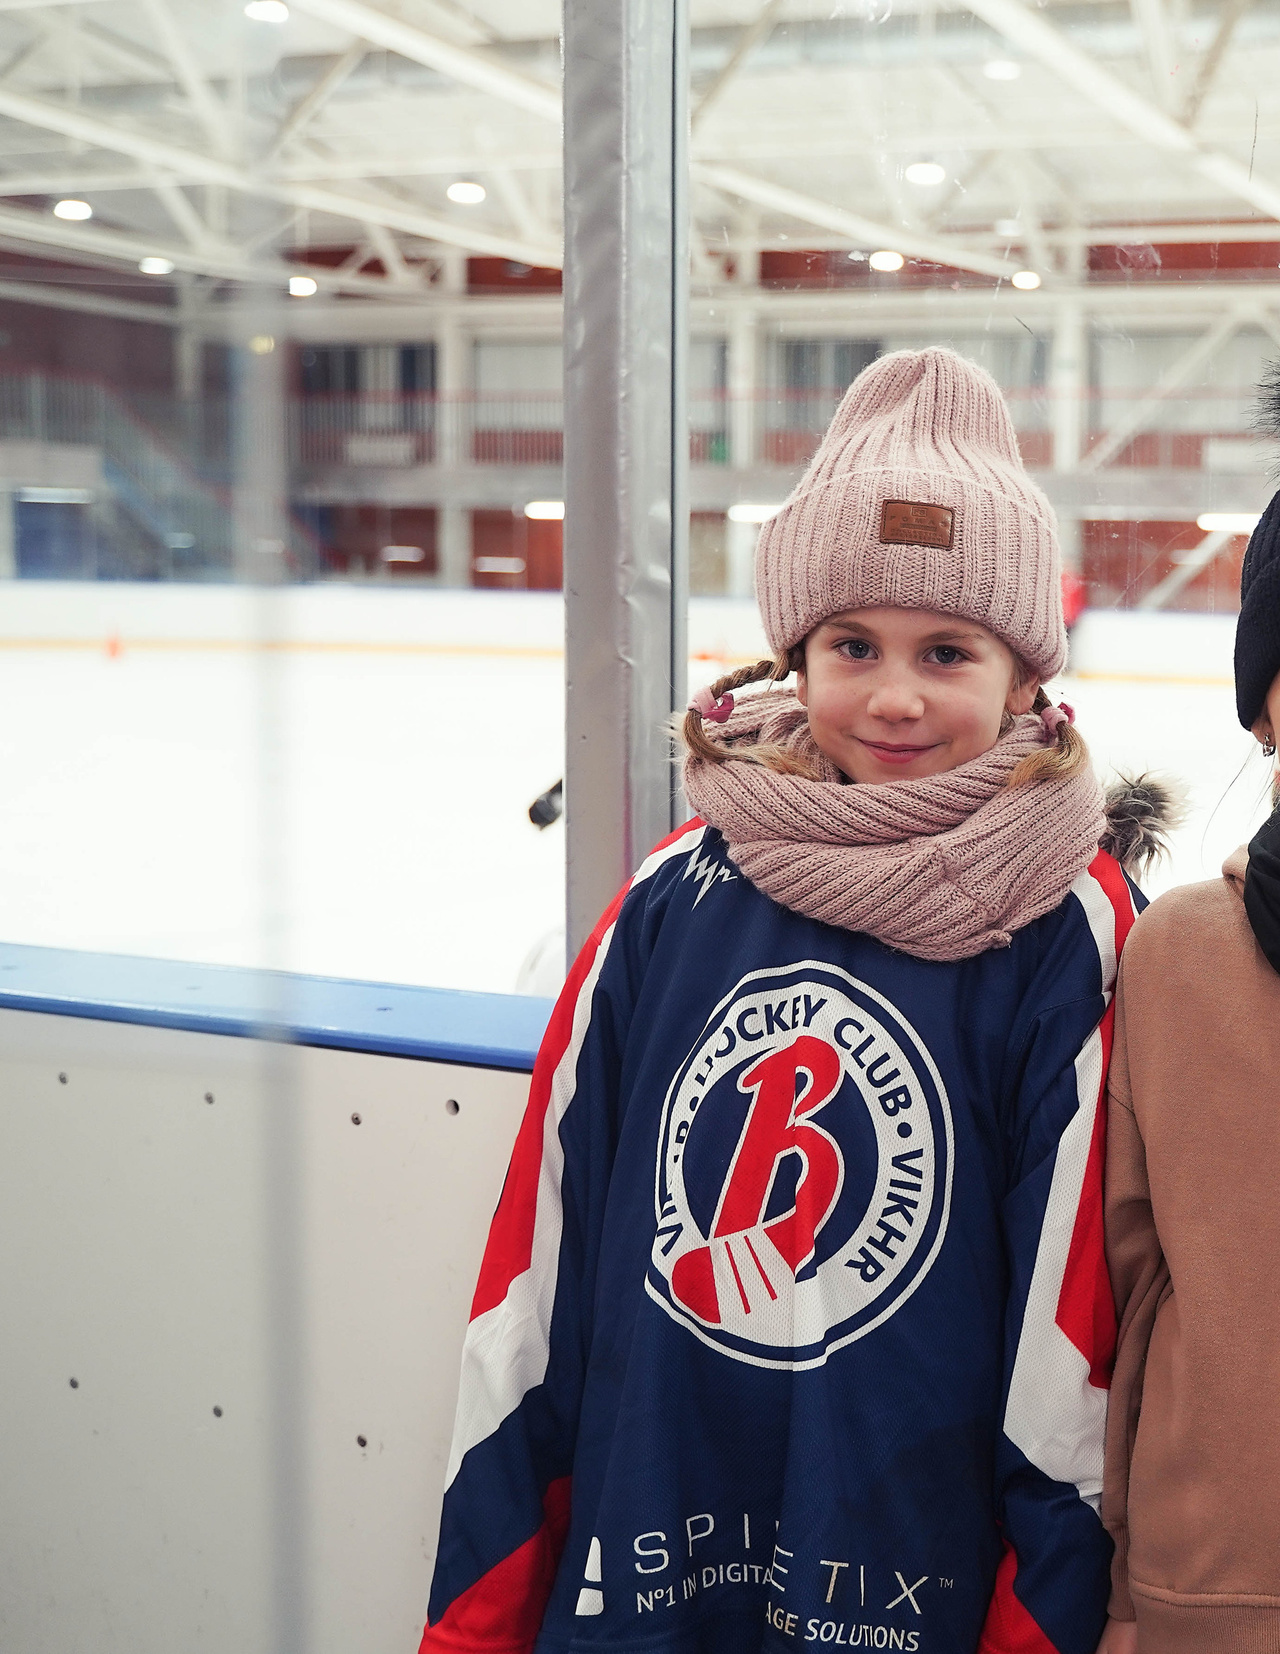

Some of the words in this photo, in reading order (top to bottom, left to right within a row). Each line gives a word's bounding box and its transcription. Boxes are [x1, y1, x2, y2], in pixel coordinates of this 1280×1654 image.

[833, 1017, 913, 1118] CLUB
[844, 1148, 925, 1284] VIKHR
[632, 1512, 929, 1615] SPIETIX
[682, 1572, 697, 1600] IN
[702, 1562, 773, 1588] DIGITA
[803, 1617, 921, 1652] SOLUTIONS
